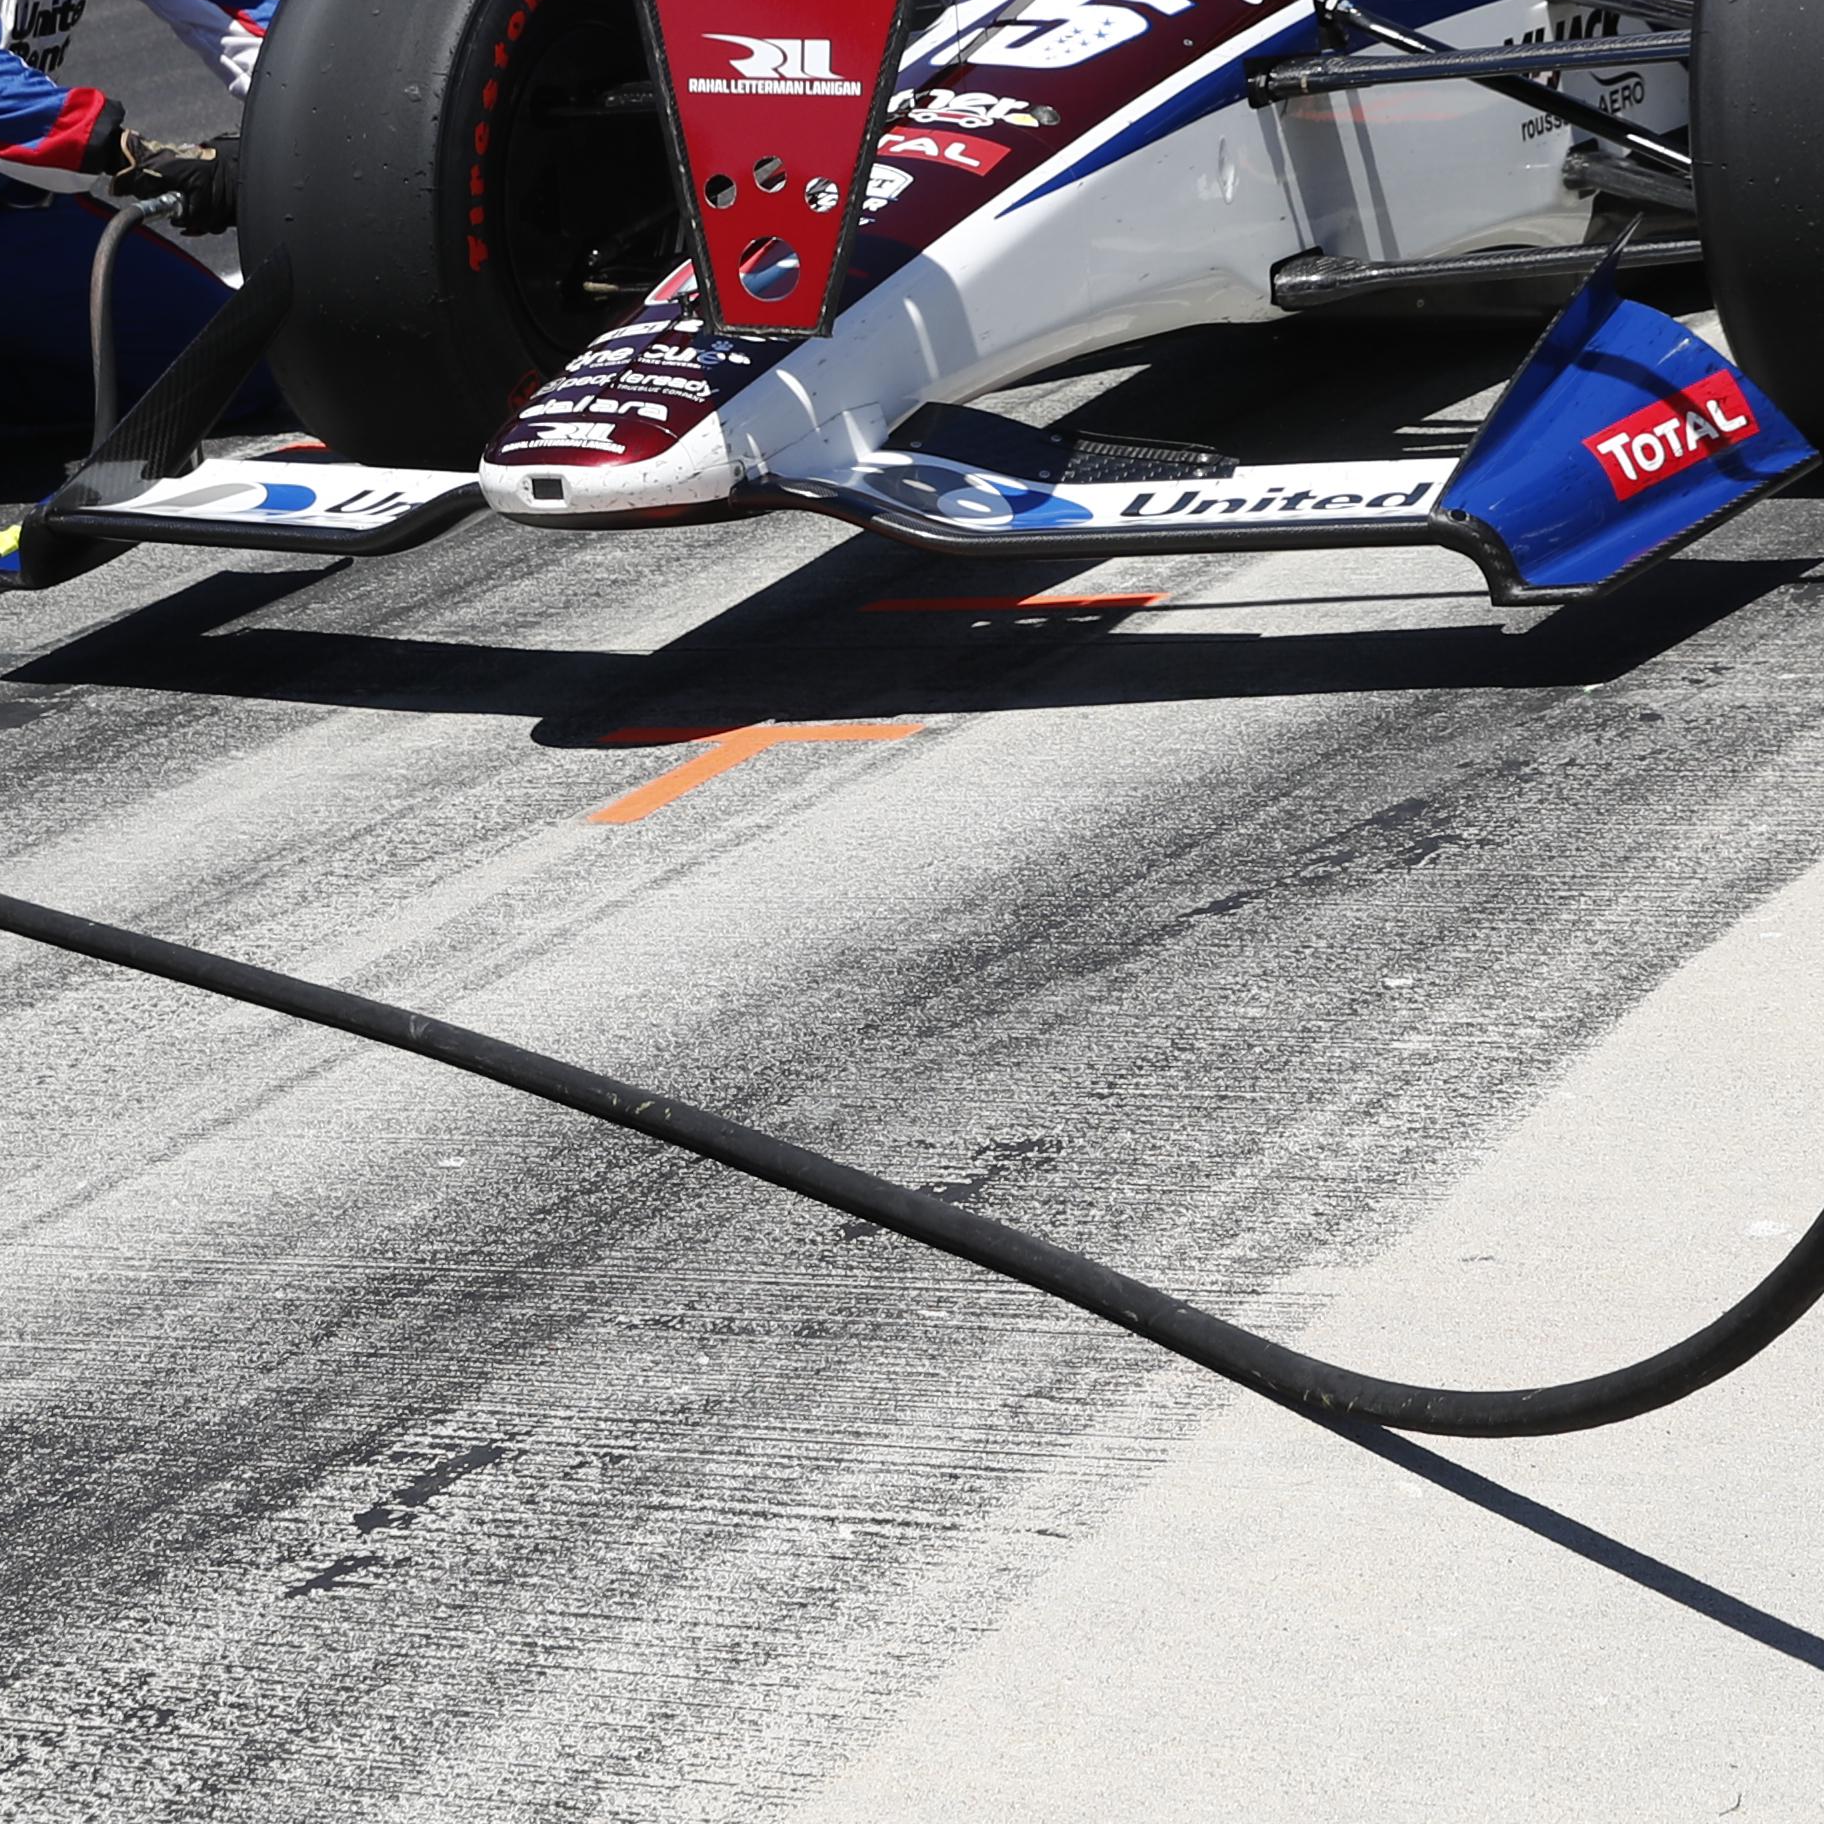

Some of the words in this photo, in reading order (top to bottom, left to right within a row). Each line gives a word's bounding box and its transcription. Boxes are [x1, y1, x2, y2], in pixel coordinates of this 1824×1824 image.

[688, 78, 730, 94] RAHAL
[730, 79, 805, 96] LETTERMAN
[805, 80, 862, 97] LANIGAN
[1598, 80, 1645, 115] AERO
[877, 133, 981, 168] TAL
[518, 394, 670, 423] dalara
[1595, 398, 1748, 481] TOTAL
[1122, 482, 1438, 520] United
